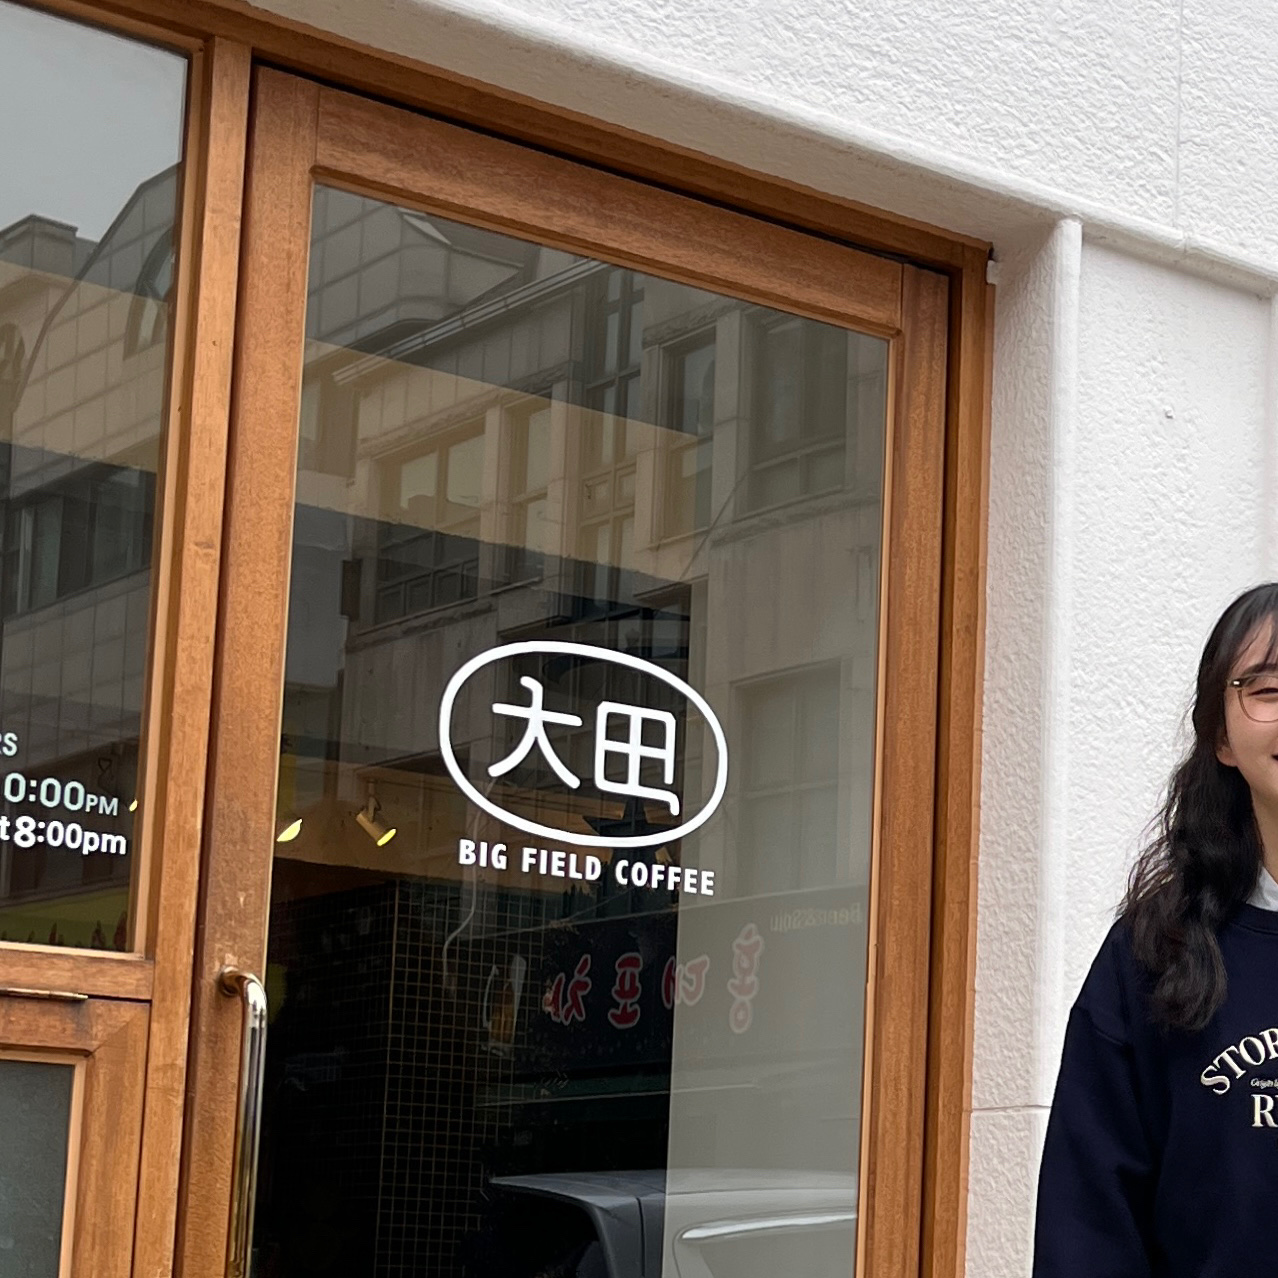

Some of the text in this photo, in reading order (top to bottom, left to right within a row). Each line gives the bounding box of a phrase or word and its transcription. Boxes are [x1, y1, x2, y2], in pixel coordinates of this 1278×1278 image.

[488, 676, 680, 816] 大田
[1, 772, 119, 816] 0:00PM
[458, 839, 715, 896] BIG FIELD COFFEE
